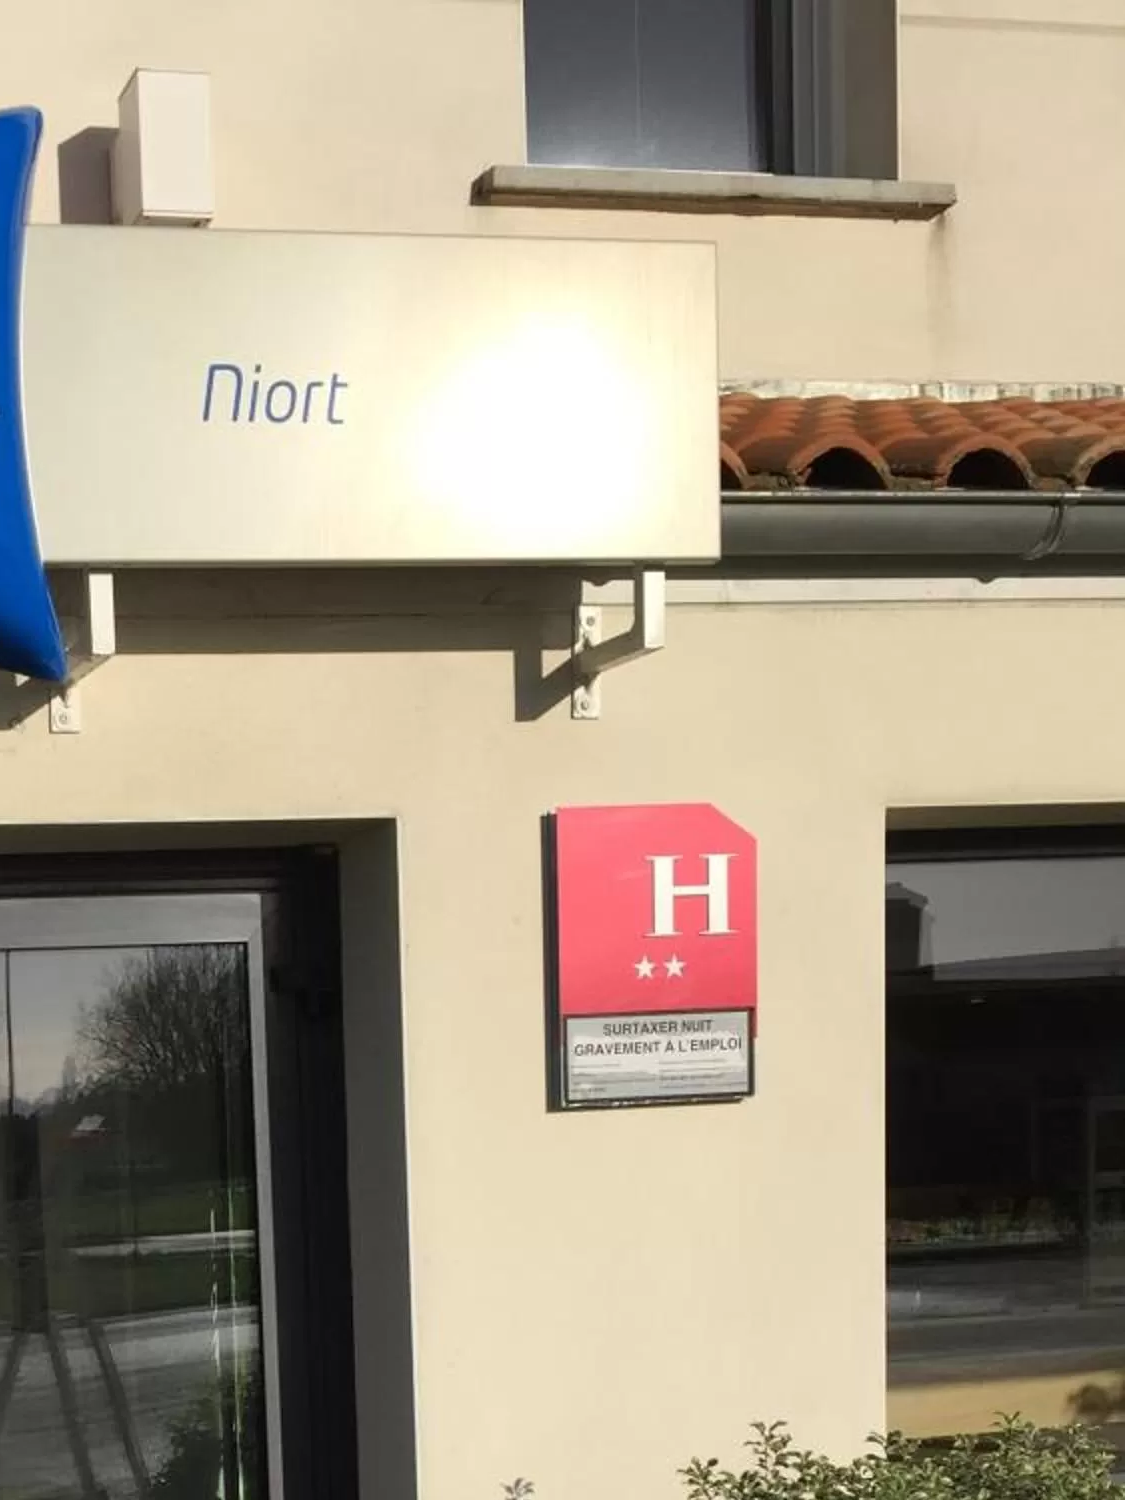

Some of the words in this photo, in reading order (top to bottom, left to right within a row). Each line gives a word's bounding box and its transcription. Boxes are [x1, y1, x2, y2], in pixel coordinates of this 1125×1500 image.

[202, 363, 348, 424] Niort
[642, 853, 739, 938] H
[575, 1041, 661, 1056] GRAVEMENT
[678, 1037, 742, 1052] L'EMPLOI
[602, 1020, 678, 1036] SURTAXER
[681, 1019, 714, 1033] NUIT
